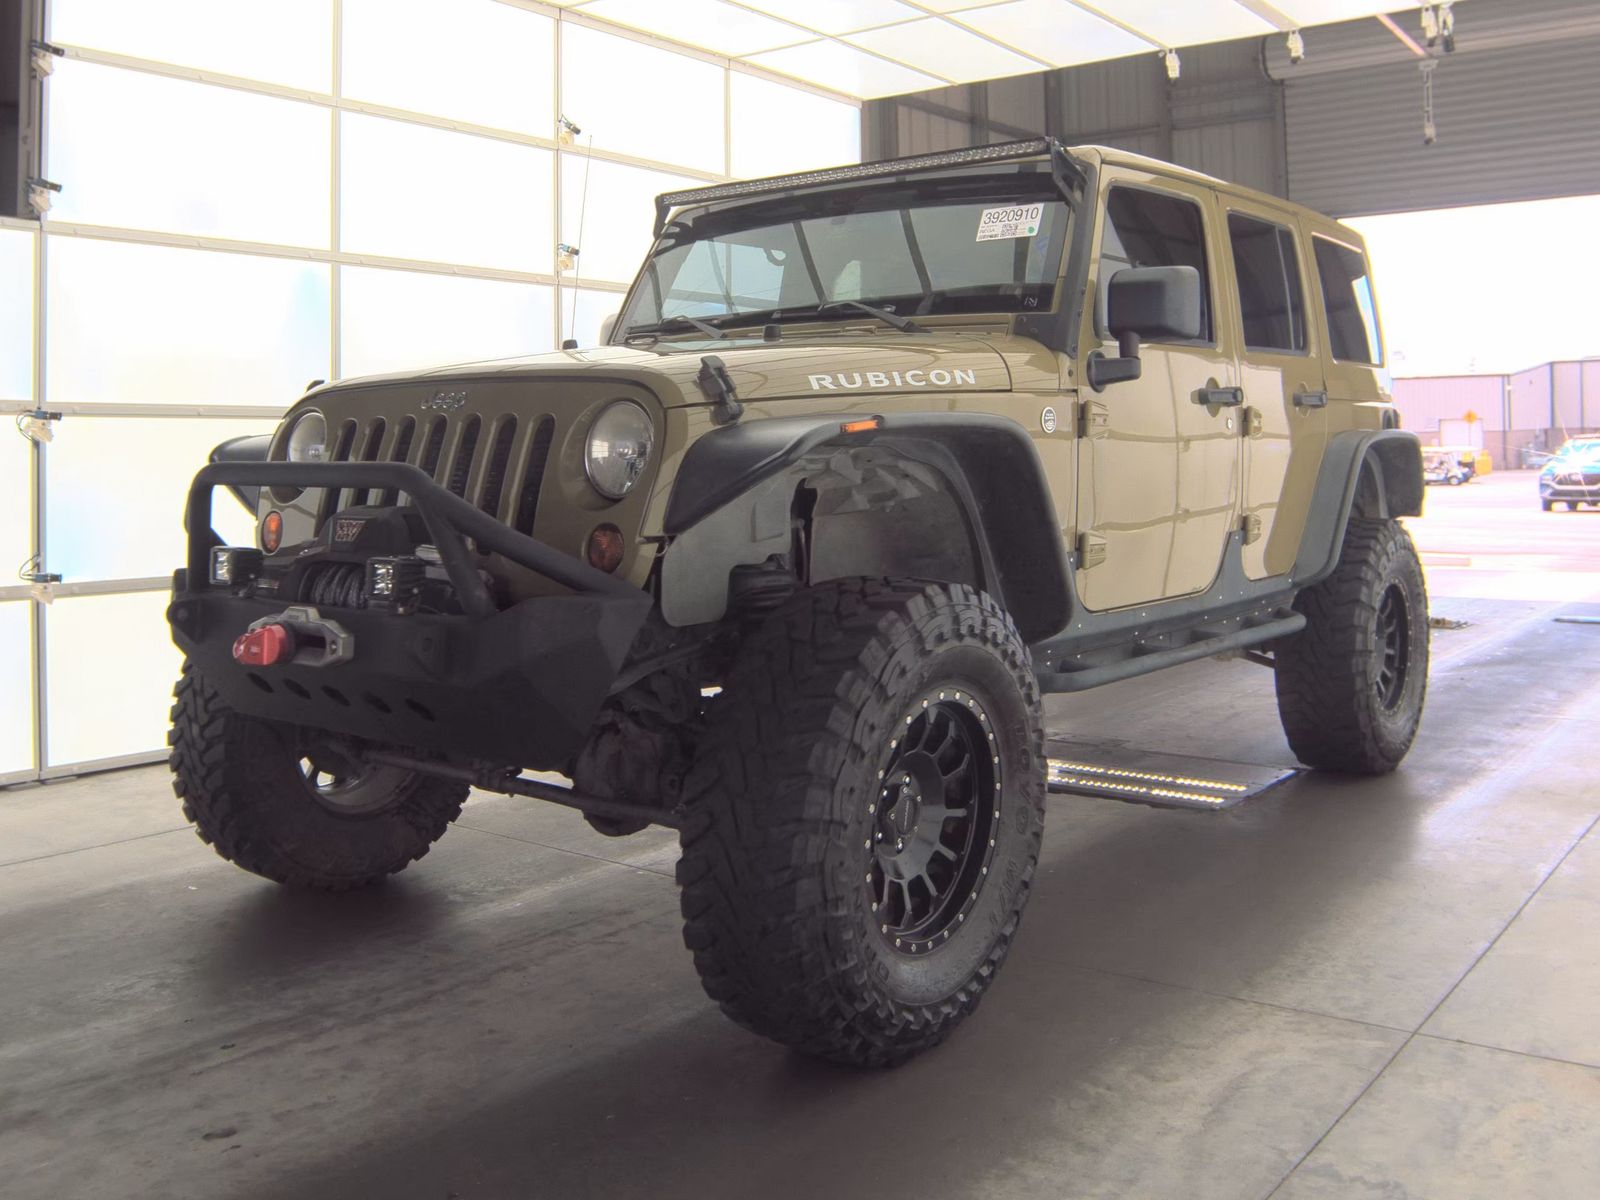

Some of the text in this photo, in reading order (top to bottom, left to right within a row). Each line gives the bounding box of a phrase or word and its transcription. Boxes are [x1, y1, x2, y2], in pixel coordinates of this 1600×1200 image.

[983, 206, 1039, 225] 3920910
[808, 369, 976, 390] RUBICON
[420, 391, 466, 411] Jeep
